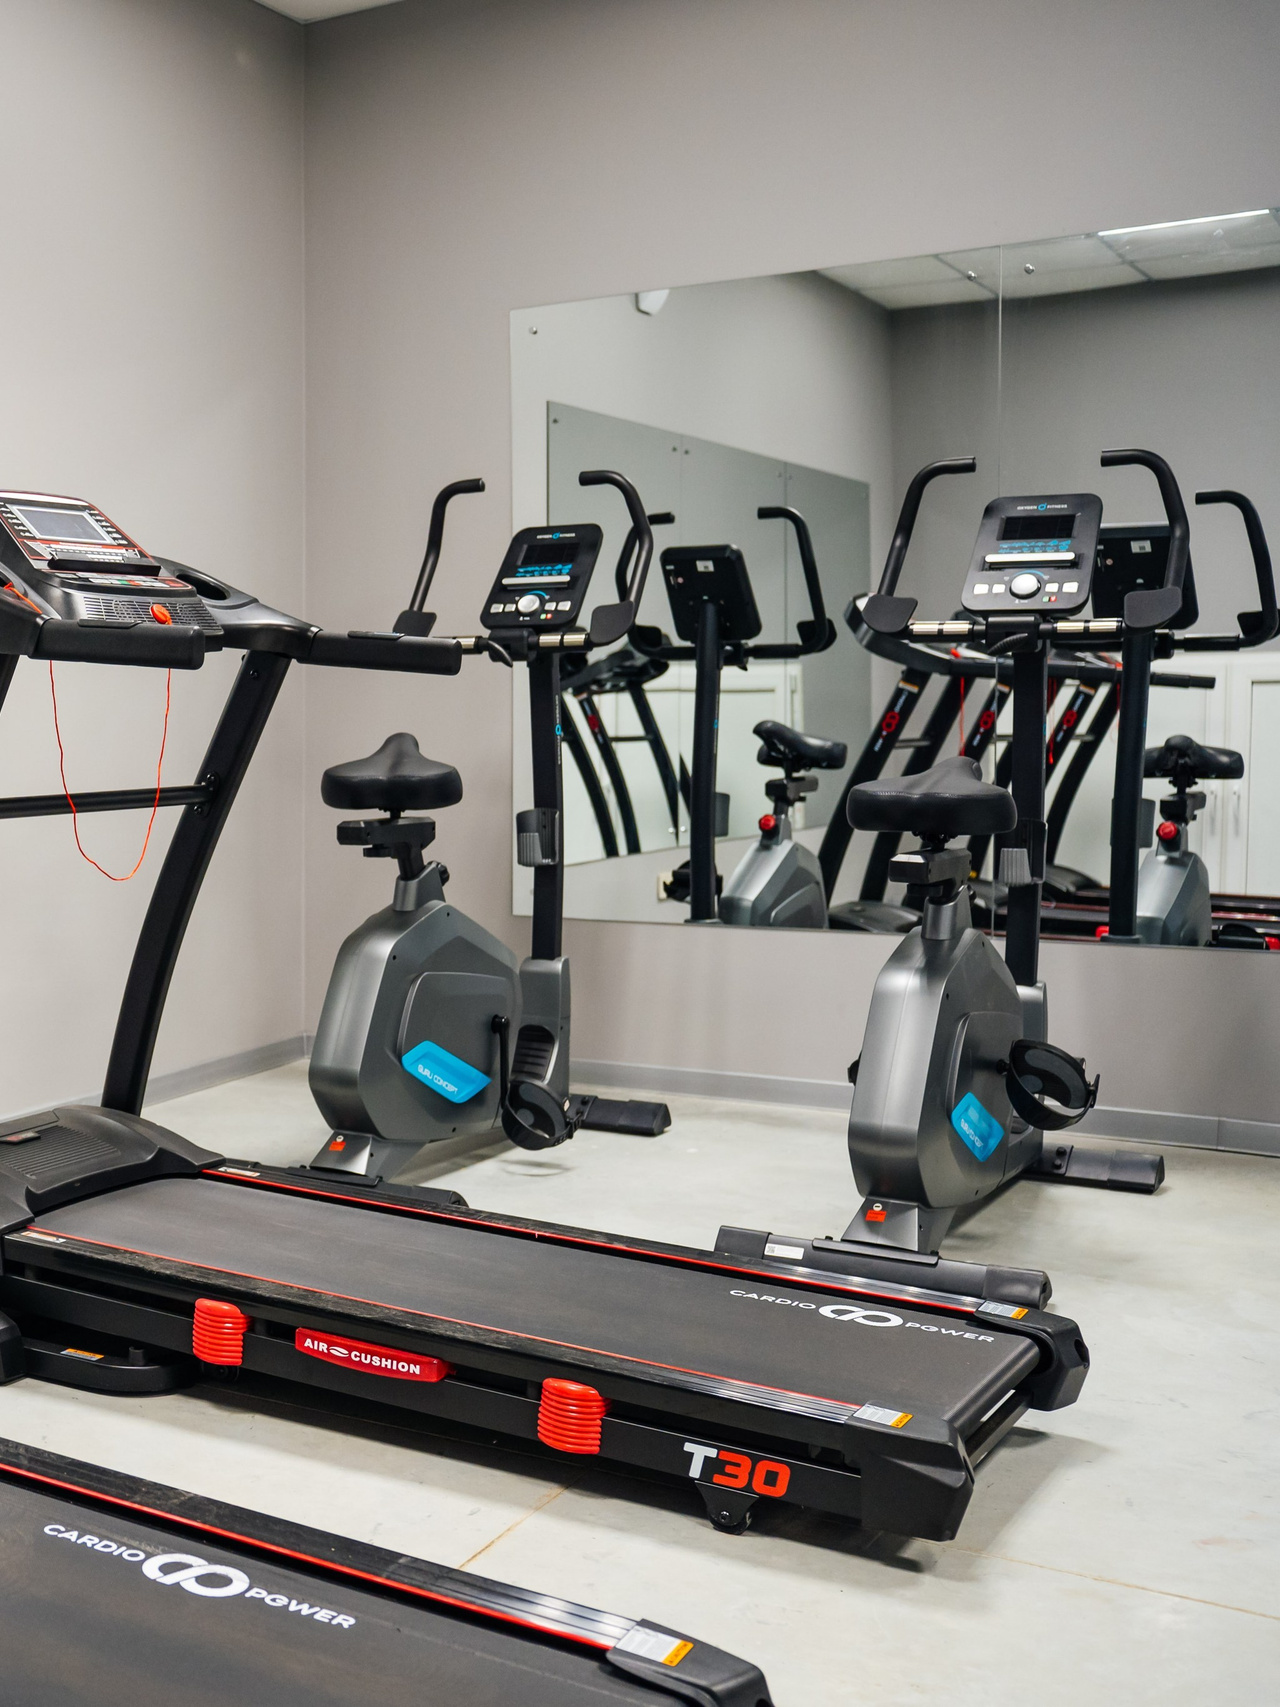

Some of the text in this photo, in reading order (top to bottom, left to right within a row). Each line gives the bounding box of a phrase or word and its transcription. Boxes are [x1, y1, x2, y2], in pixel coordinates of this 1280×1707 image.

[729, 1289, 995, 1344] CARDIO POWER
[304, 1338, 421, 1375] AIR CUSHION
[683, 1442, 791, 1498] T30
[42, 1523, 357, 1629] CARDIO POWER
